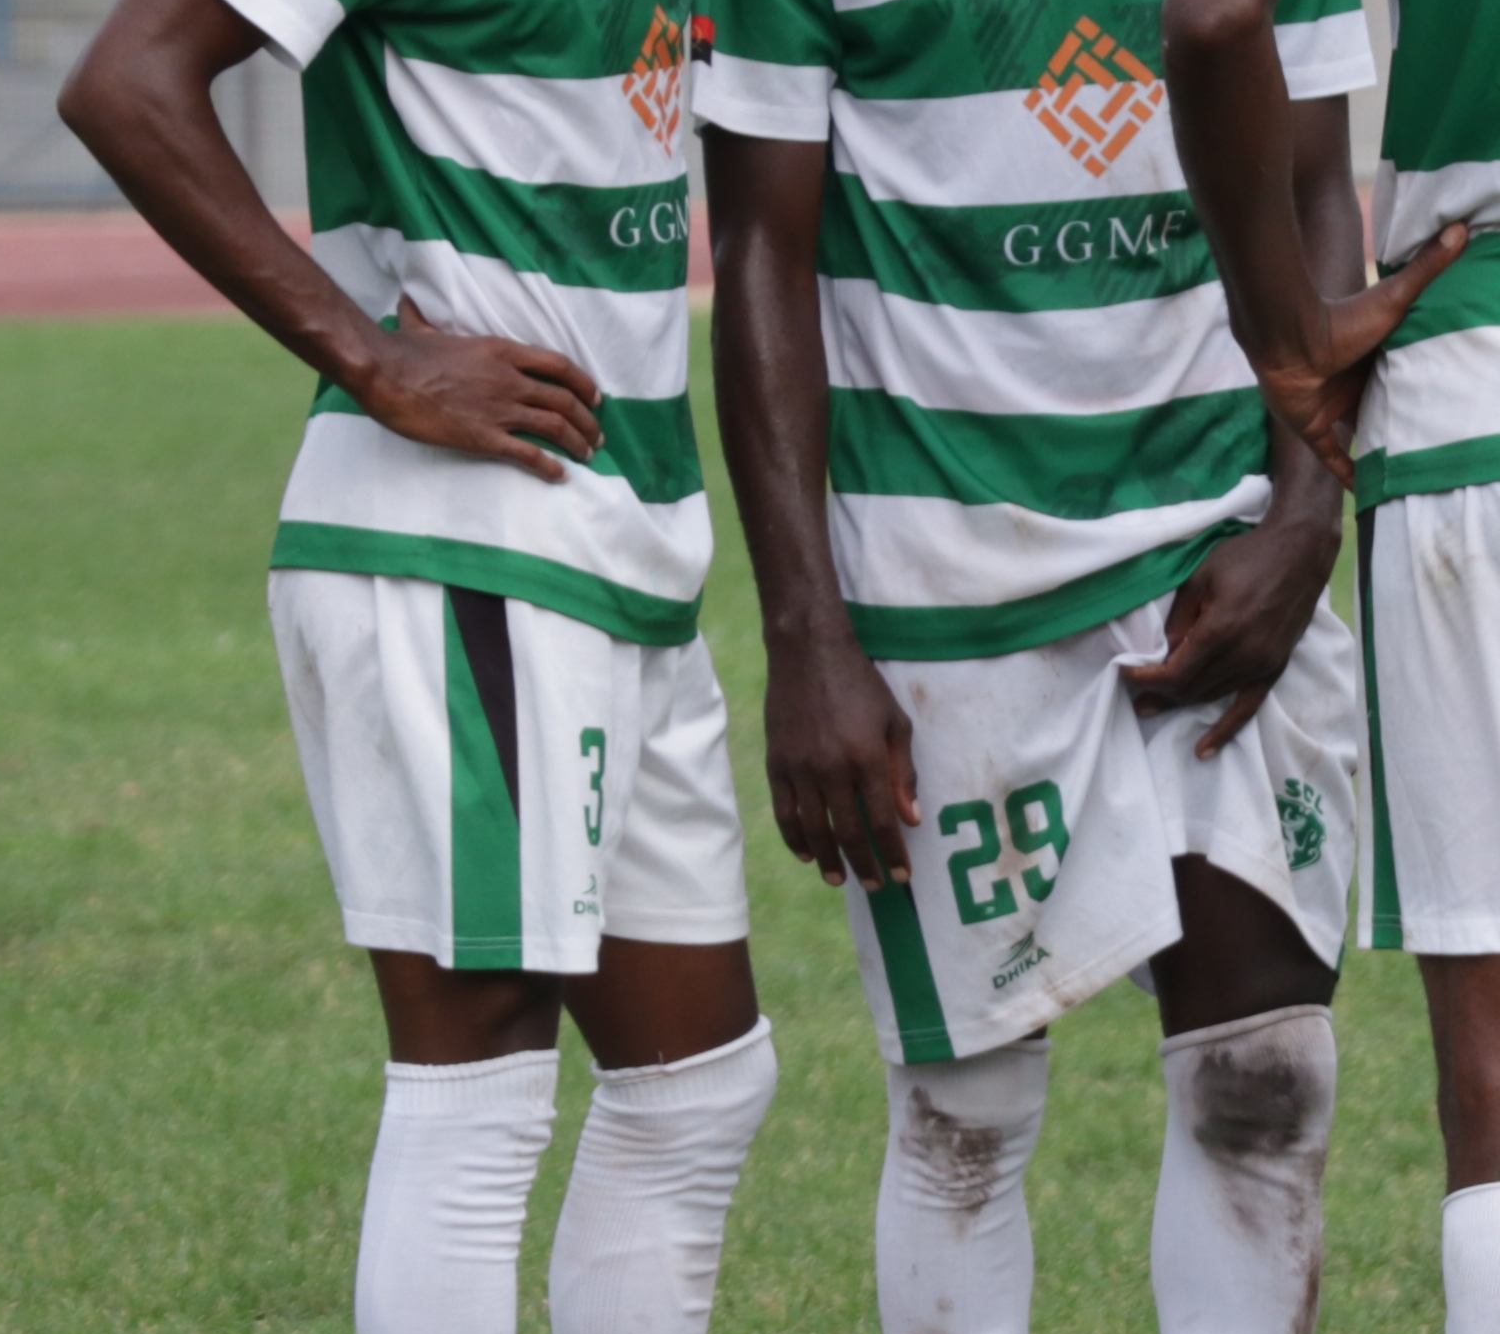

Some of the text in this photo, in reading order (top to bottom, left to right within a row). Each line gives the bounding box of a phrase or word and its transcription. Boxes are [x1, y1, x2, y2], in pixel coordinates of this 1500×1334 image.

[609, 195, 688, 247] GGM
[1003, 209, 1187, 266] GGMF
[1284, 778, 1323, 816] SCL
[937, 779, 1070, 926] 29
[992, 946, 1051, 989] DHIKA
